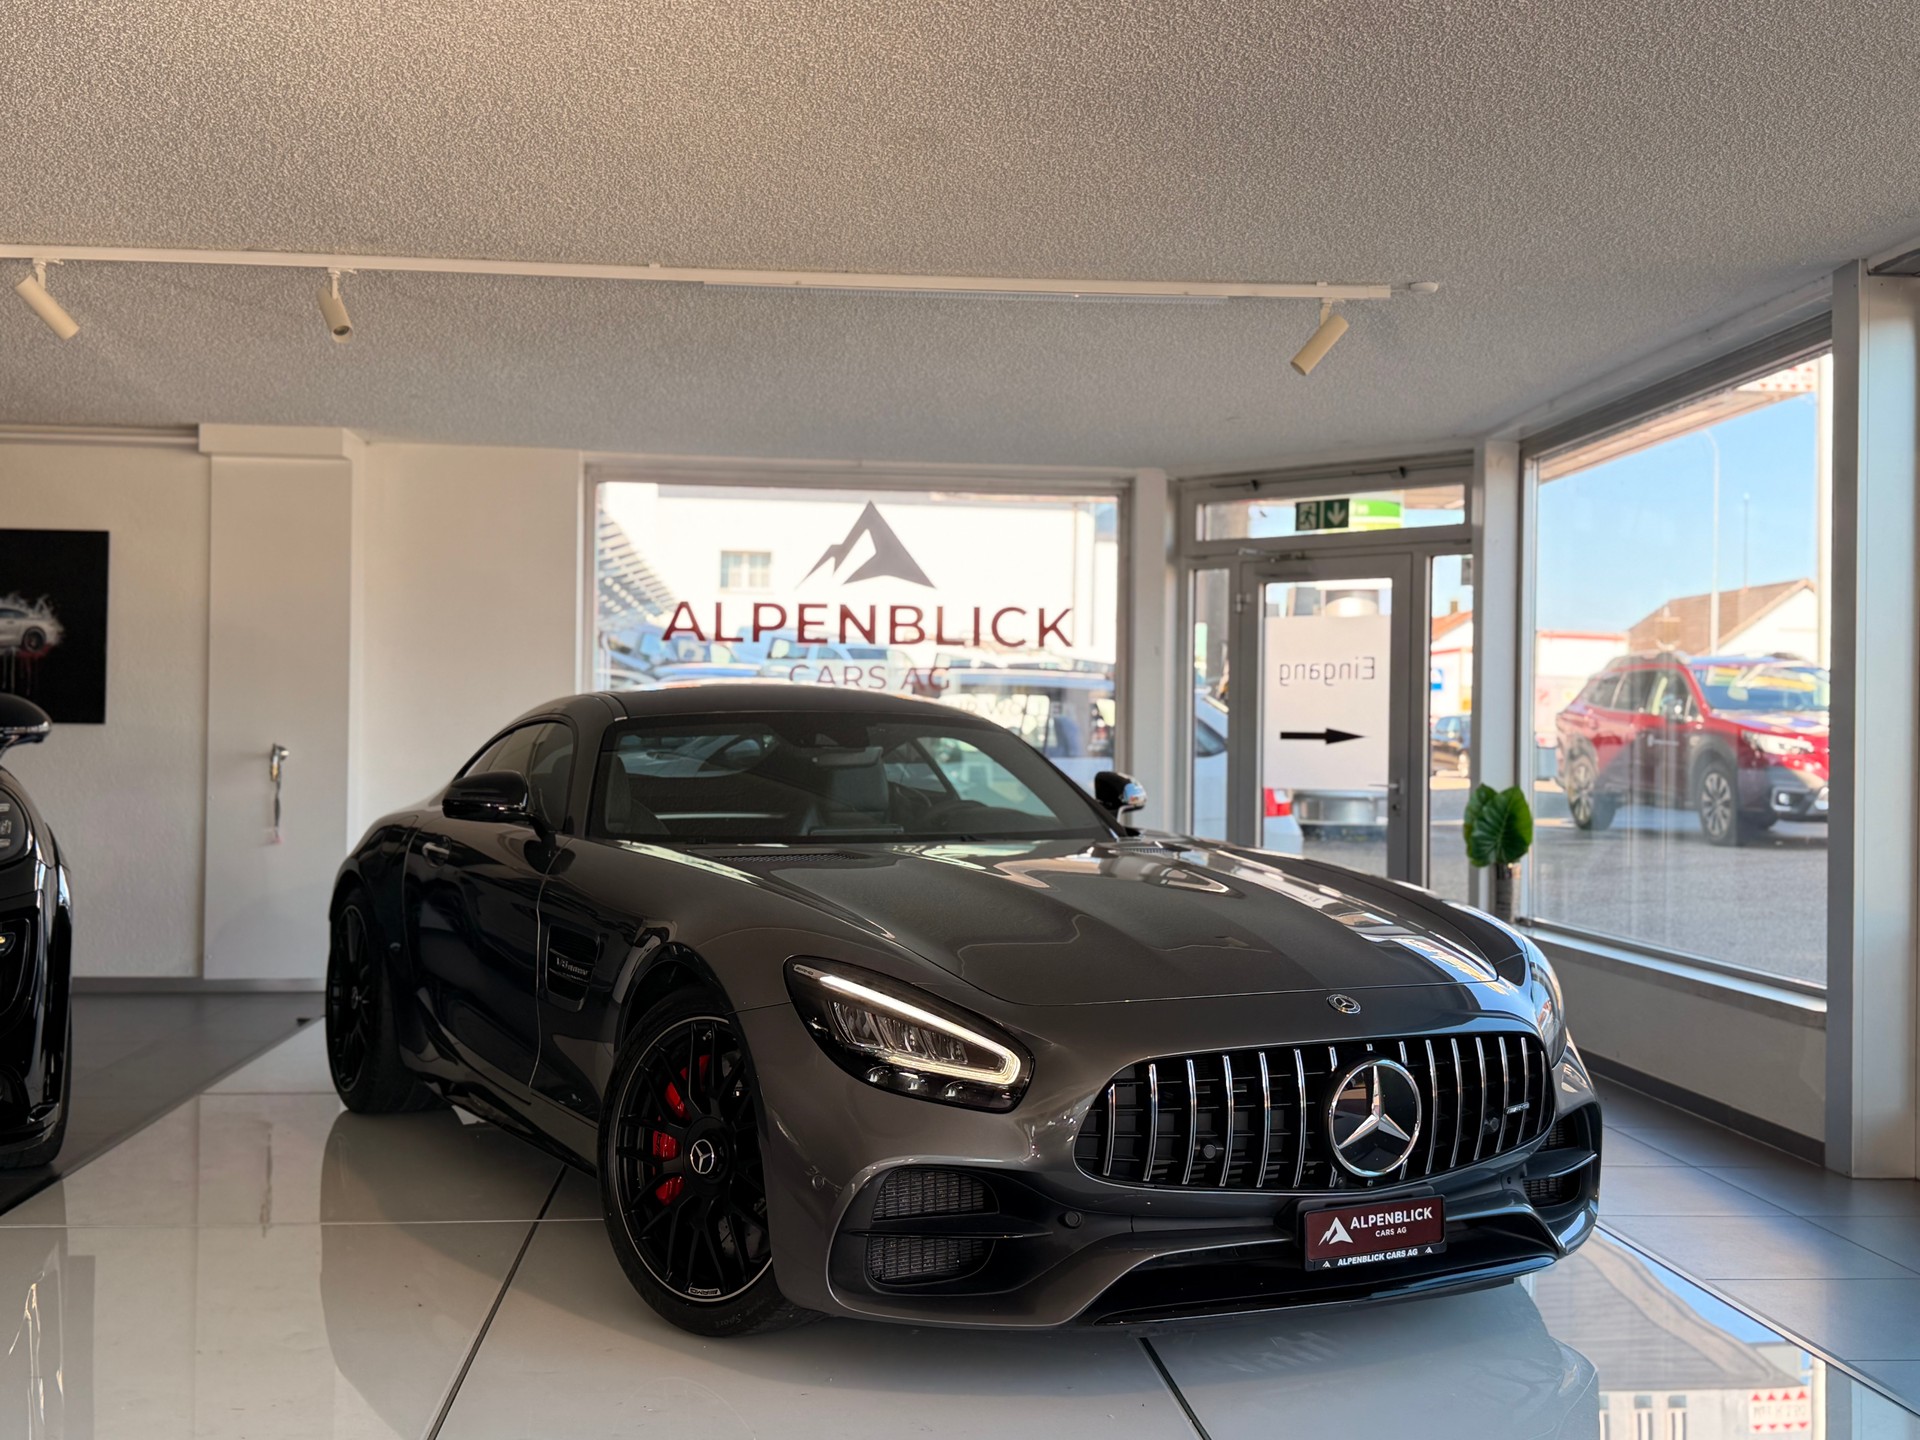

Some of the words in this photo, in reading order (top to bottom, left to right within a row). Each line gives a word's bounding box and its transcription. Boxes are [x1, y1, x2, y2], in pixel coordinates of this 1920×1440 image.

[662, 600, 1073, 648] ALPENBLICK
[788, 664, 887, 690] CARS
[900, 667, 950, 691] AG
[1350, 1206, 1433, 1230] ALPENBLICK
[1375, 1228, 1395, 1238] CARS
[1396, 1226, 1407, 1235] AG
[1337, 1253, 1385, 1266] ALPENBLICK
[1386, 1250, 1406, 1260] CARS
[1406, 1248, 1418, 1257] AG
